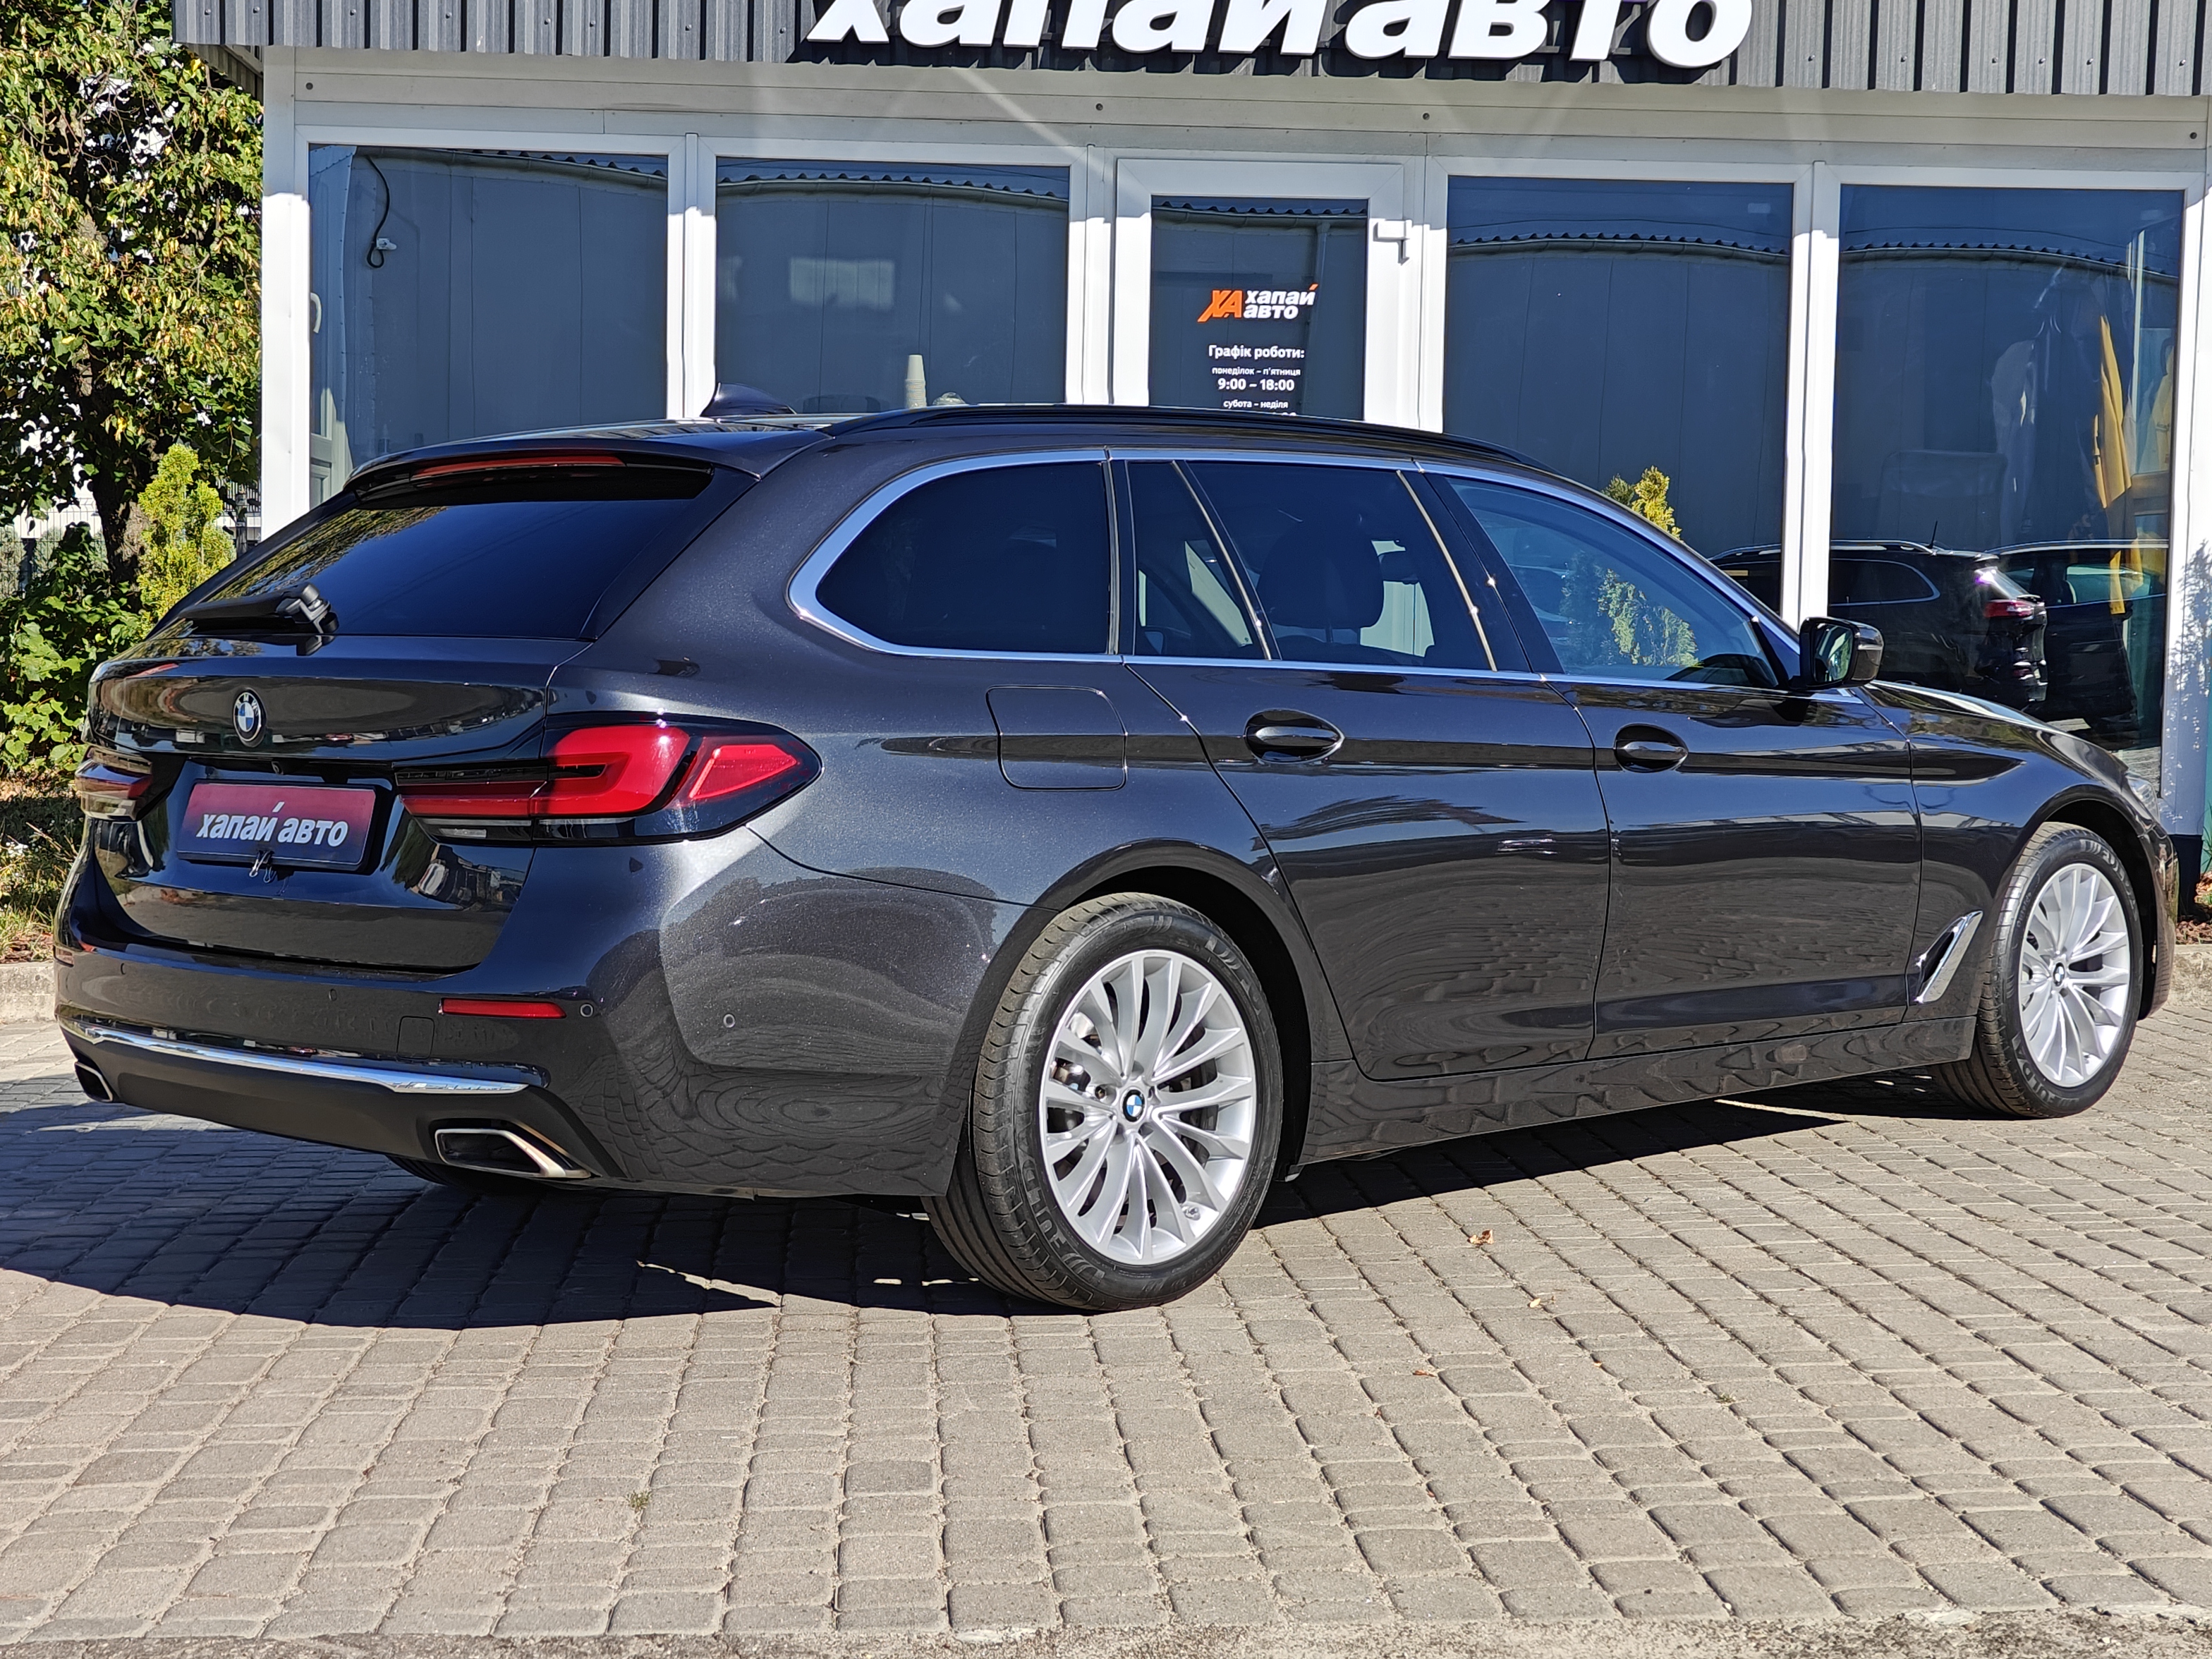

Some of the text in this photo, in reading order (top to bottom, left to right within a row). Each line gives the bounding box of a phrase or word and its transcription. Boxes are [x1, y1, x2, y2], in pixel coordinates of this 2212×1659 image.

[1243, 304, 1299, 320] авто
[1208, 344, 1305, 360] Графік роботи:
[1212, 366, 1255, 375] понеділок
[1217, 378, 1246, 390] 9:00
[1260, 379, 1295, 391] 18:00
[1223, 399, 1253, 408] субота
[1260, 400, 1289, 409] неділя
[277, 818, 348, 847] авто
[1017, 1118, 1066, 1250] FULDA
